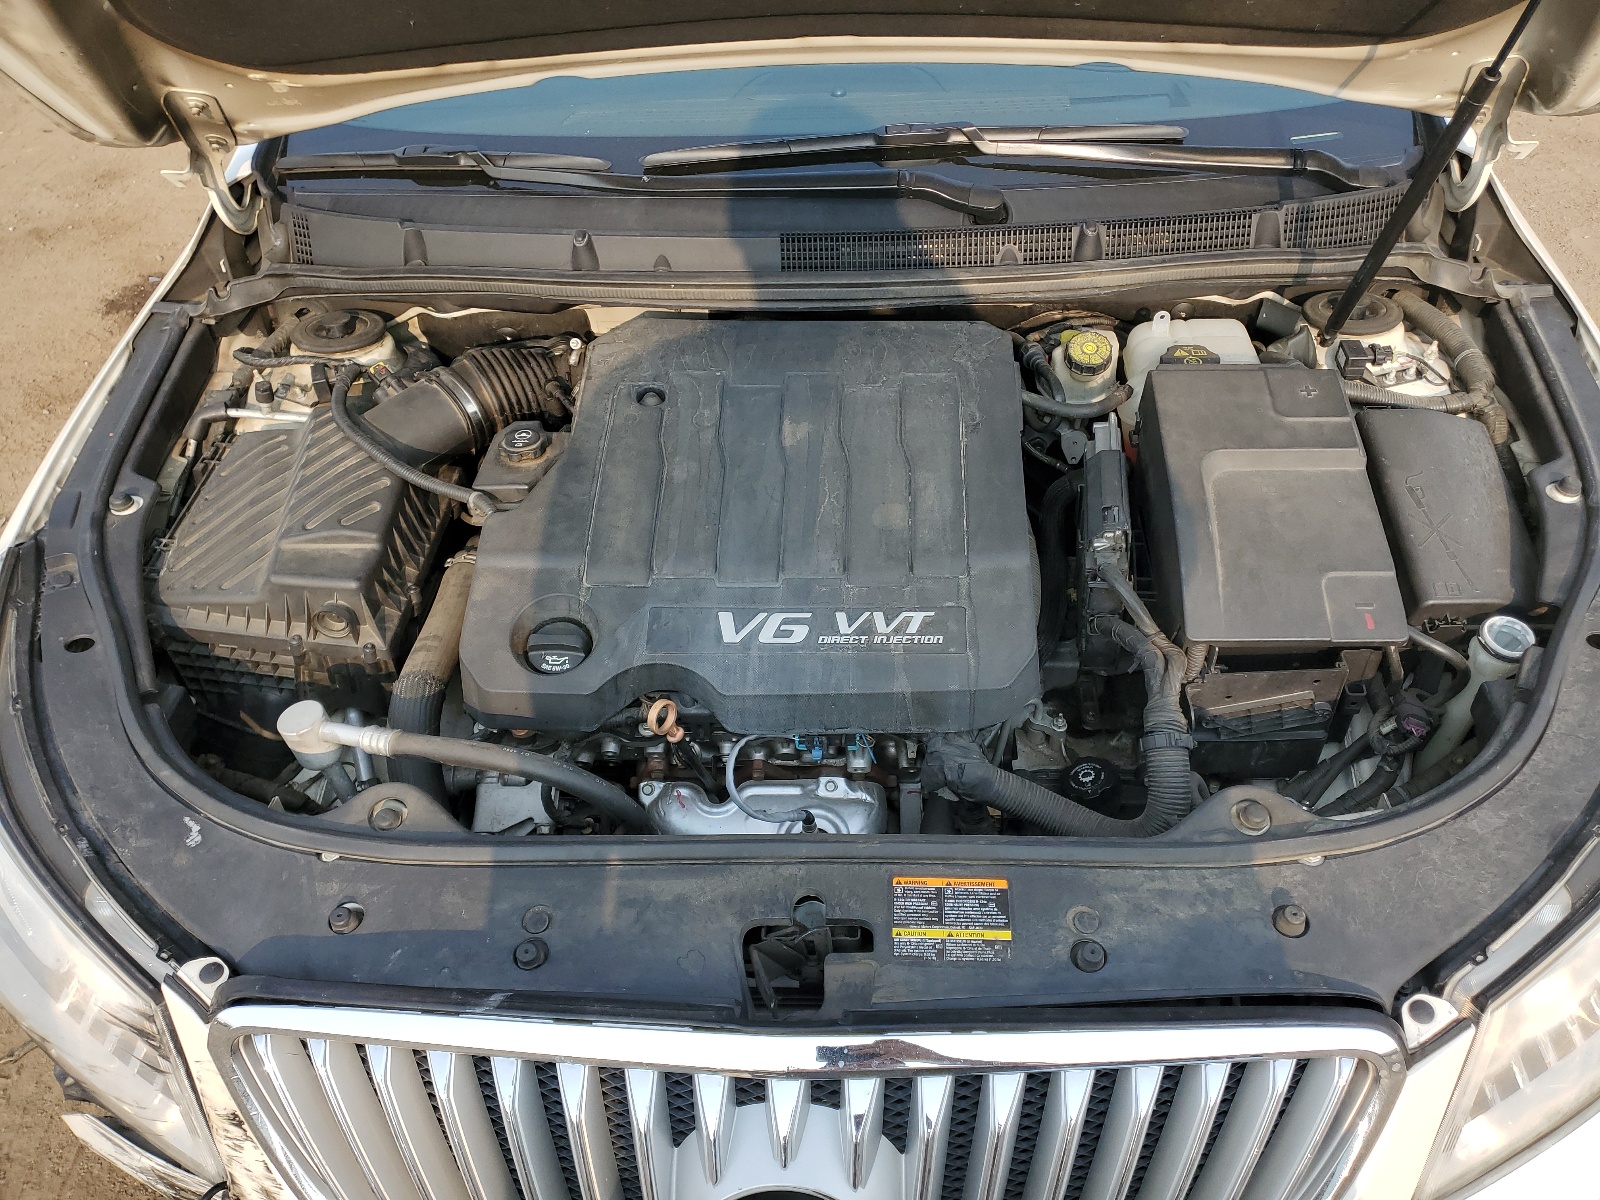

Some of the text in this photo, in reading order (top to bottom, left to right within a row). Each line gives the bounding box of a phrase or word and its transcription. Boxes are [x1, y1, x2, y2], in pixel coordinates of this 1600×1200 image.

[717, 611, 935, 644] V6 VVT
[818, 635, 944, 645] DIRECT INJECTION
